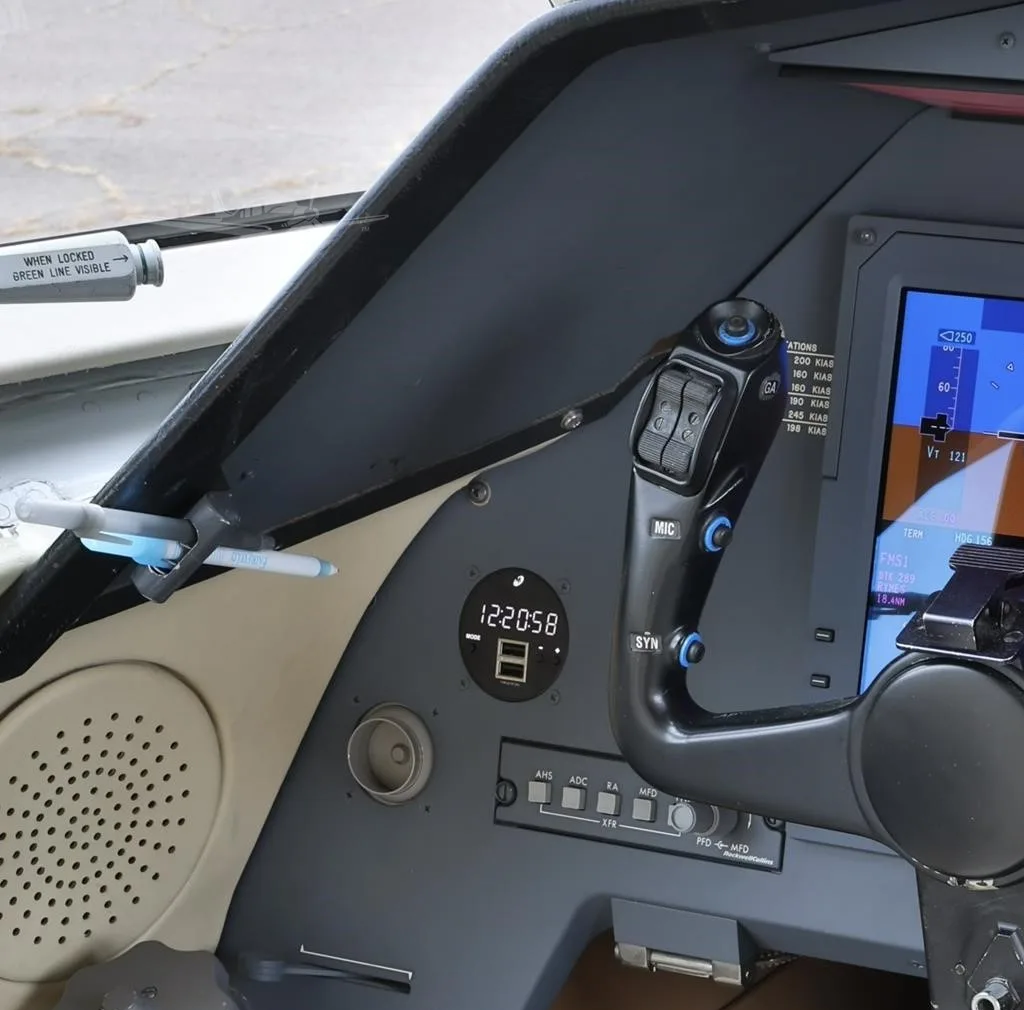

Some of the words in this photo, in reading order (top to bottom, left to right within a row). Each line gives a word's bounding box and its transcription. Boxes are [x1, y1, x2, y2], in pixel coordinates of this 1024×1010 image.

[24, 254, 53, 266] WHEN
[58, 251, 95, 263] LOCKED
[12, 270, 45, 281] GREEN
[50, 266, 72, 278] LINE
[75, 262, 111, 274] VISIBLE
[955, 332, 972, 343] 250
[794, 356, 811, 366] 200
[815, 359, 834, 368] KIAS
[814, 373, 833, 381] KIAS
[764, 382, 776, 394] GA
[790, 398, 804, 406] 190
[811, 400, 830, 408] KIAS
[788, 411, 804, 419] 245
[809, 413, 828, 422] KIAS
[787, 424, 800, 432] 198
[950, 451, 965, 462] 121
[655, 521, 675, 535] MIC
[480, 604, 558, 636] 12:20:58
[465, 633, 481, 641] MODE
[635, 636, 659, 650] SYN
[536, 770, 552, 780] AHS
[569, 776, 588, 786] ADC
[639, 788, 658, 797] MFD
[602, 818, 616, 828] XFR
[696, 837, 711, 847] PFD
[730, 844, 749, 853] MFD
